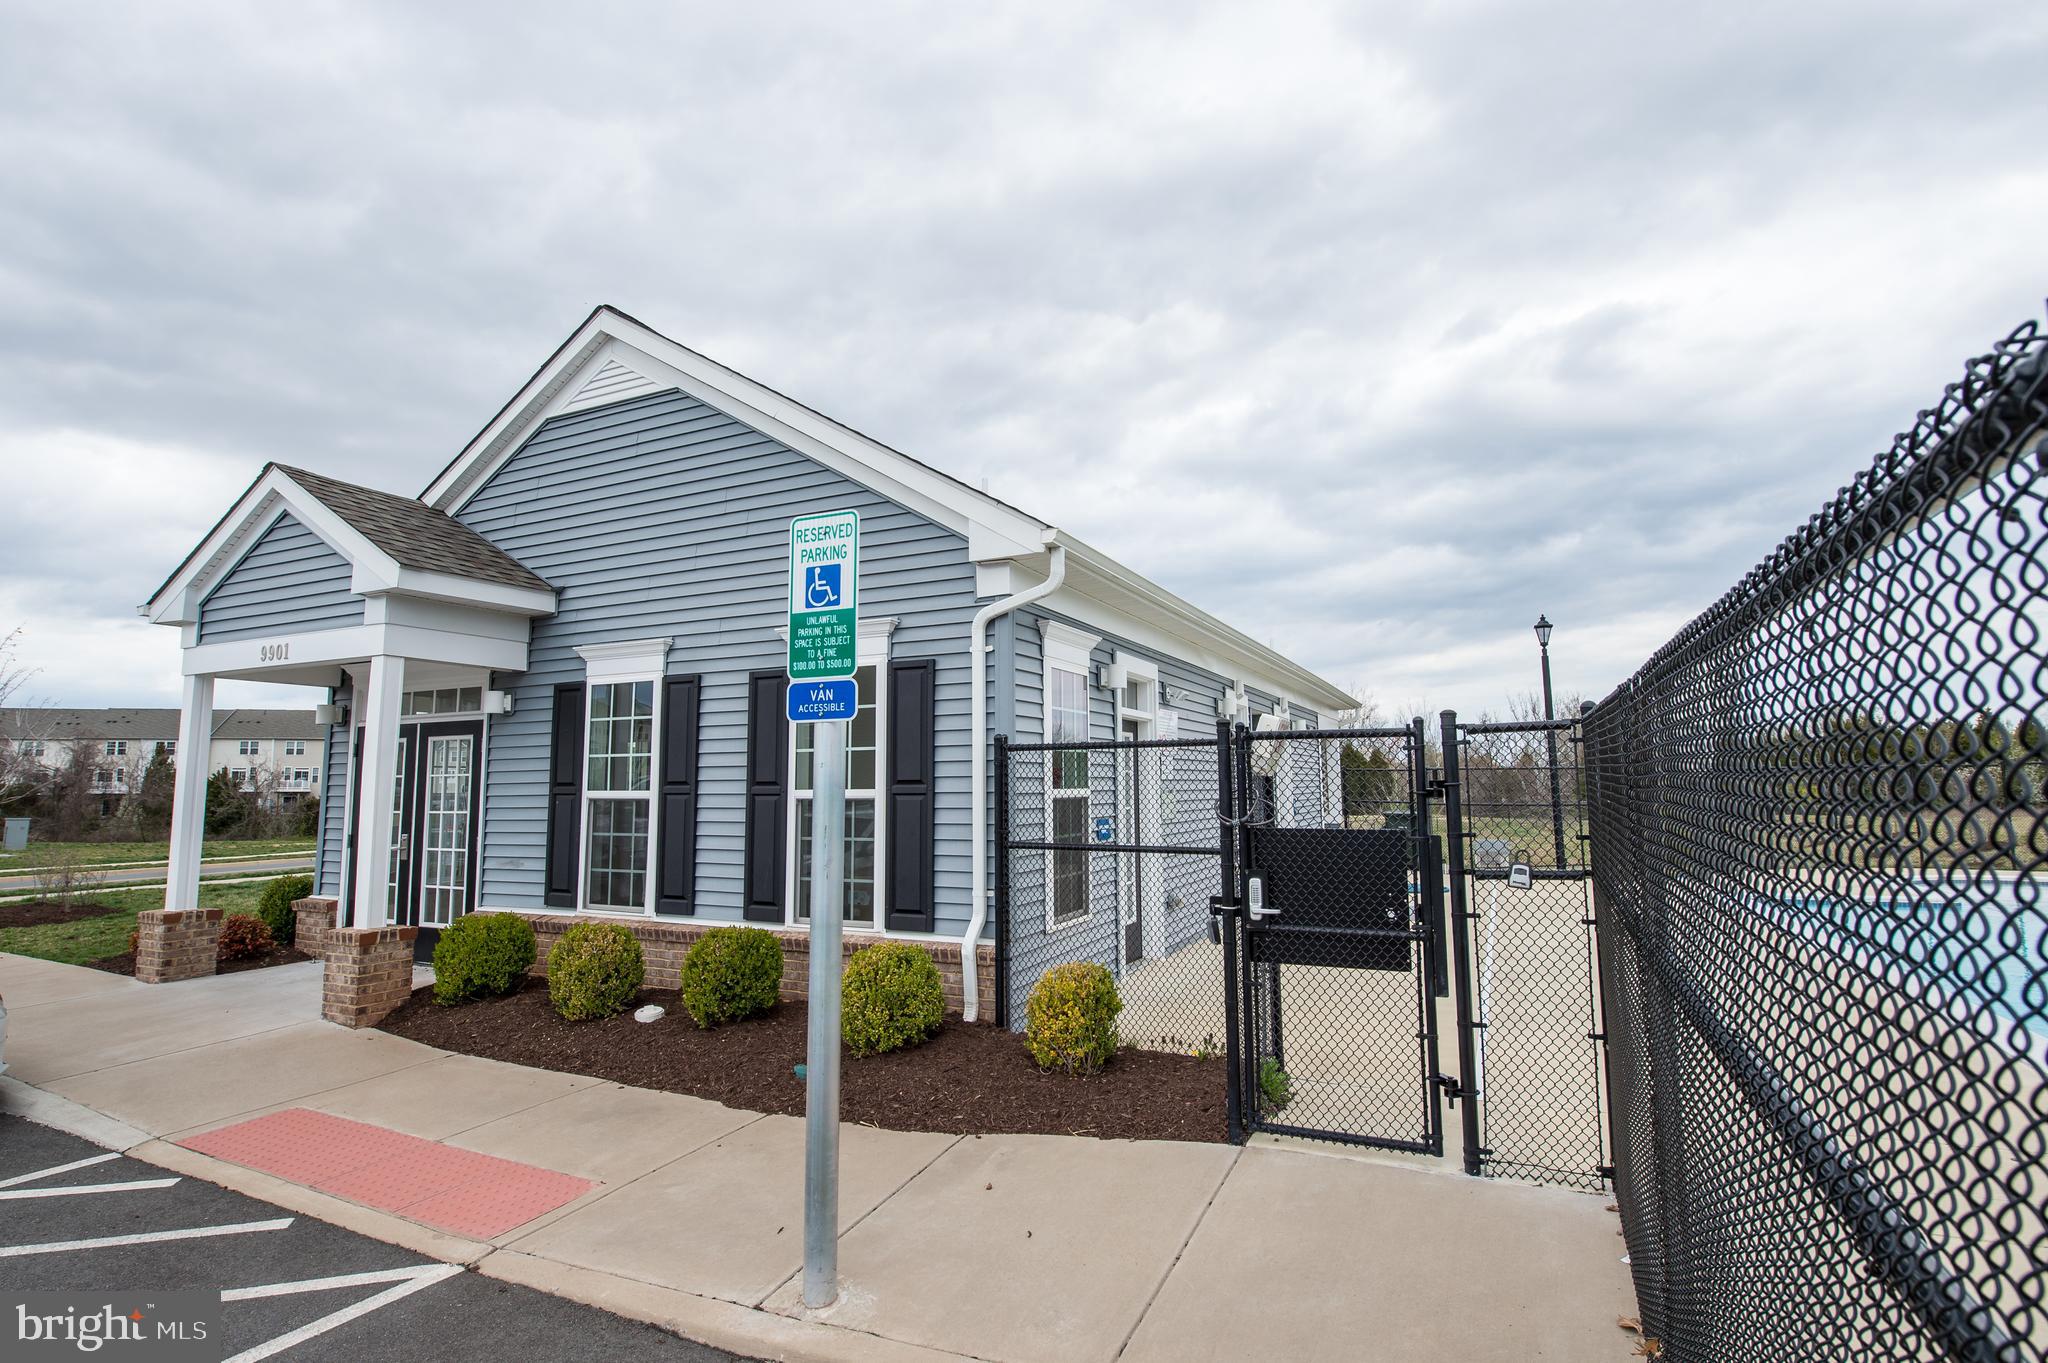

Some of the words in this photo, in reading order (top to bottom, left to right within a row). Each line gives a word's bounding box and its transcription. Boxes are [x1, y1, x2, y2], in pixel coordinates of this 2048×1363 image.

[796, 523, 853, 544] RESERVED
[801, 543, 848, 563] PARKING
[806, 614, 839, 625] UNLAWFUL
[797, 627, 823, 637] PARKING
[824, 626, 832, 635] IN
[833, 625, 848, 635] THIS
[794, 639, 813, 648] SPACE
[815, 638, 822, 647] IS
[823, 636, 851, 646] SUBJECT
[260, 643, 289, 662] 9901
[807, 649, 815, 658] TO
[816, 649, 822, 658] A
[823, 648, 837, 657] FINE
[793, 661, 816, 671] $100.00
[817, 660, 825, 669] TO
[826, 658, 852, 669] $500.00
[810, 689, 834, 702] VAN
[798, 702, 845, 713] ACCESSIBLE
